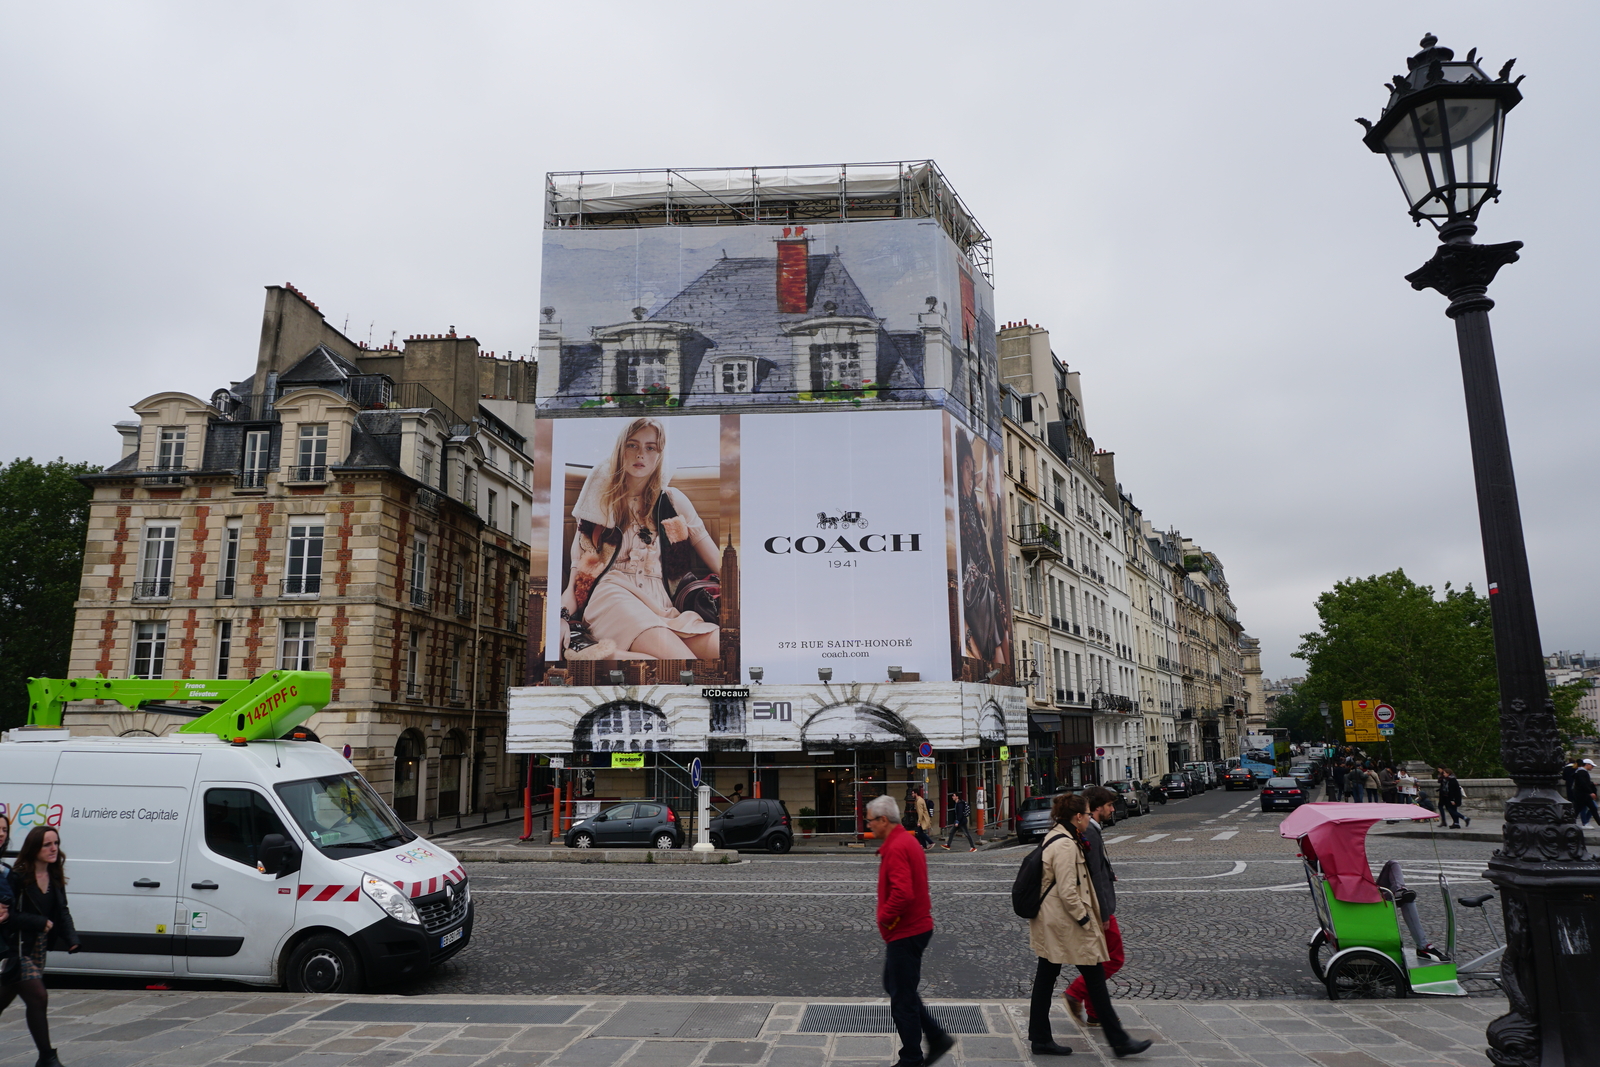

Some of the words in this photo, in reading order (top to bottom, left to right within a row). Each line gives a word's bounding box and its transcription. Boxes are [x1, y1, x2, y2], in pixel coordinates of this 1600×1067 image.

[764, 533, 922, 554] COACH
[828, 560, 858, 568] 1941
[801, 641, 824, 649] RUE
[827, 637, 913, 648] SAINT-HONORÉ
[821, 650, 870, 659] coach.com
[702, 689, 749, 697] JCDecaux
[70, 807, 79, 818] la
[82, 807, 118, 819] lumière
[120, 809, 135, 820] est
[138, 808, 179, 822] Capitale
